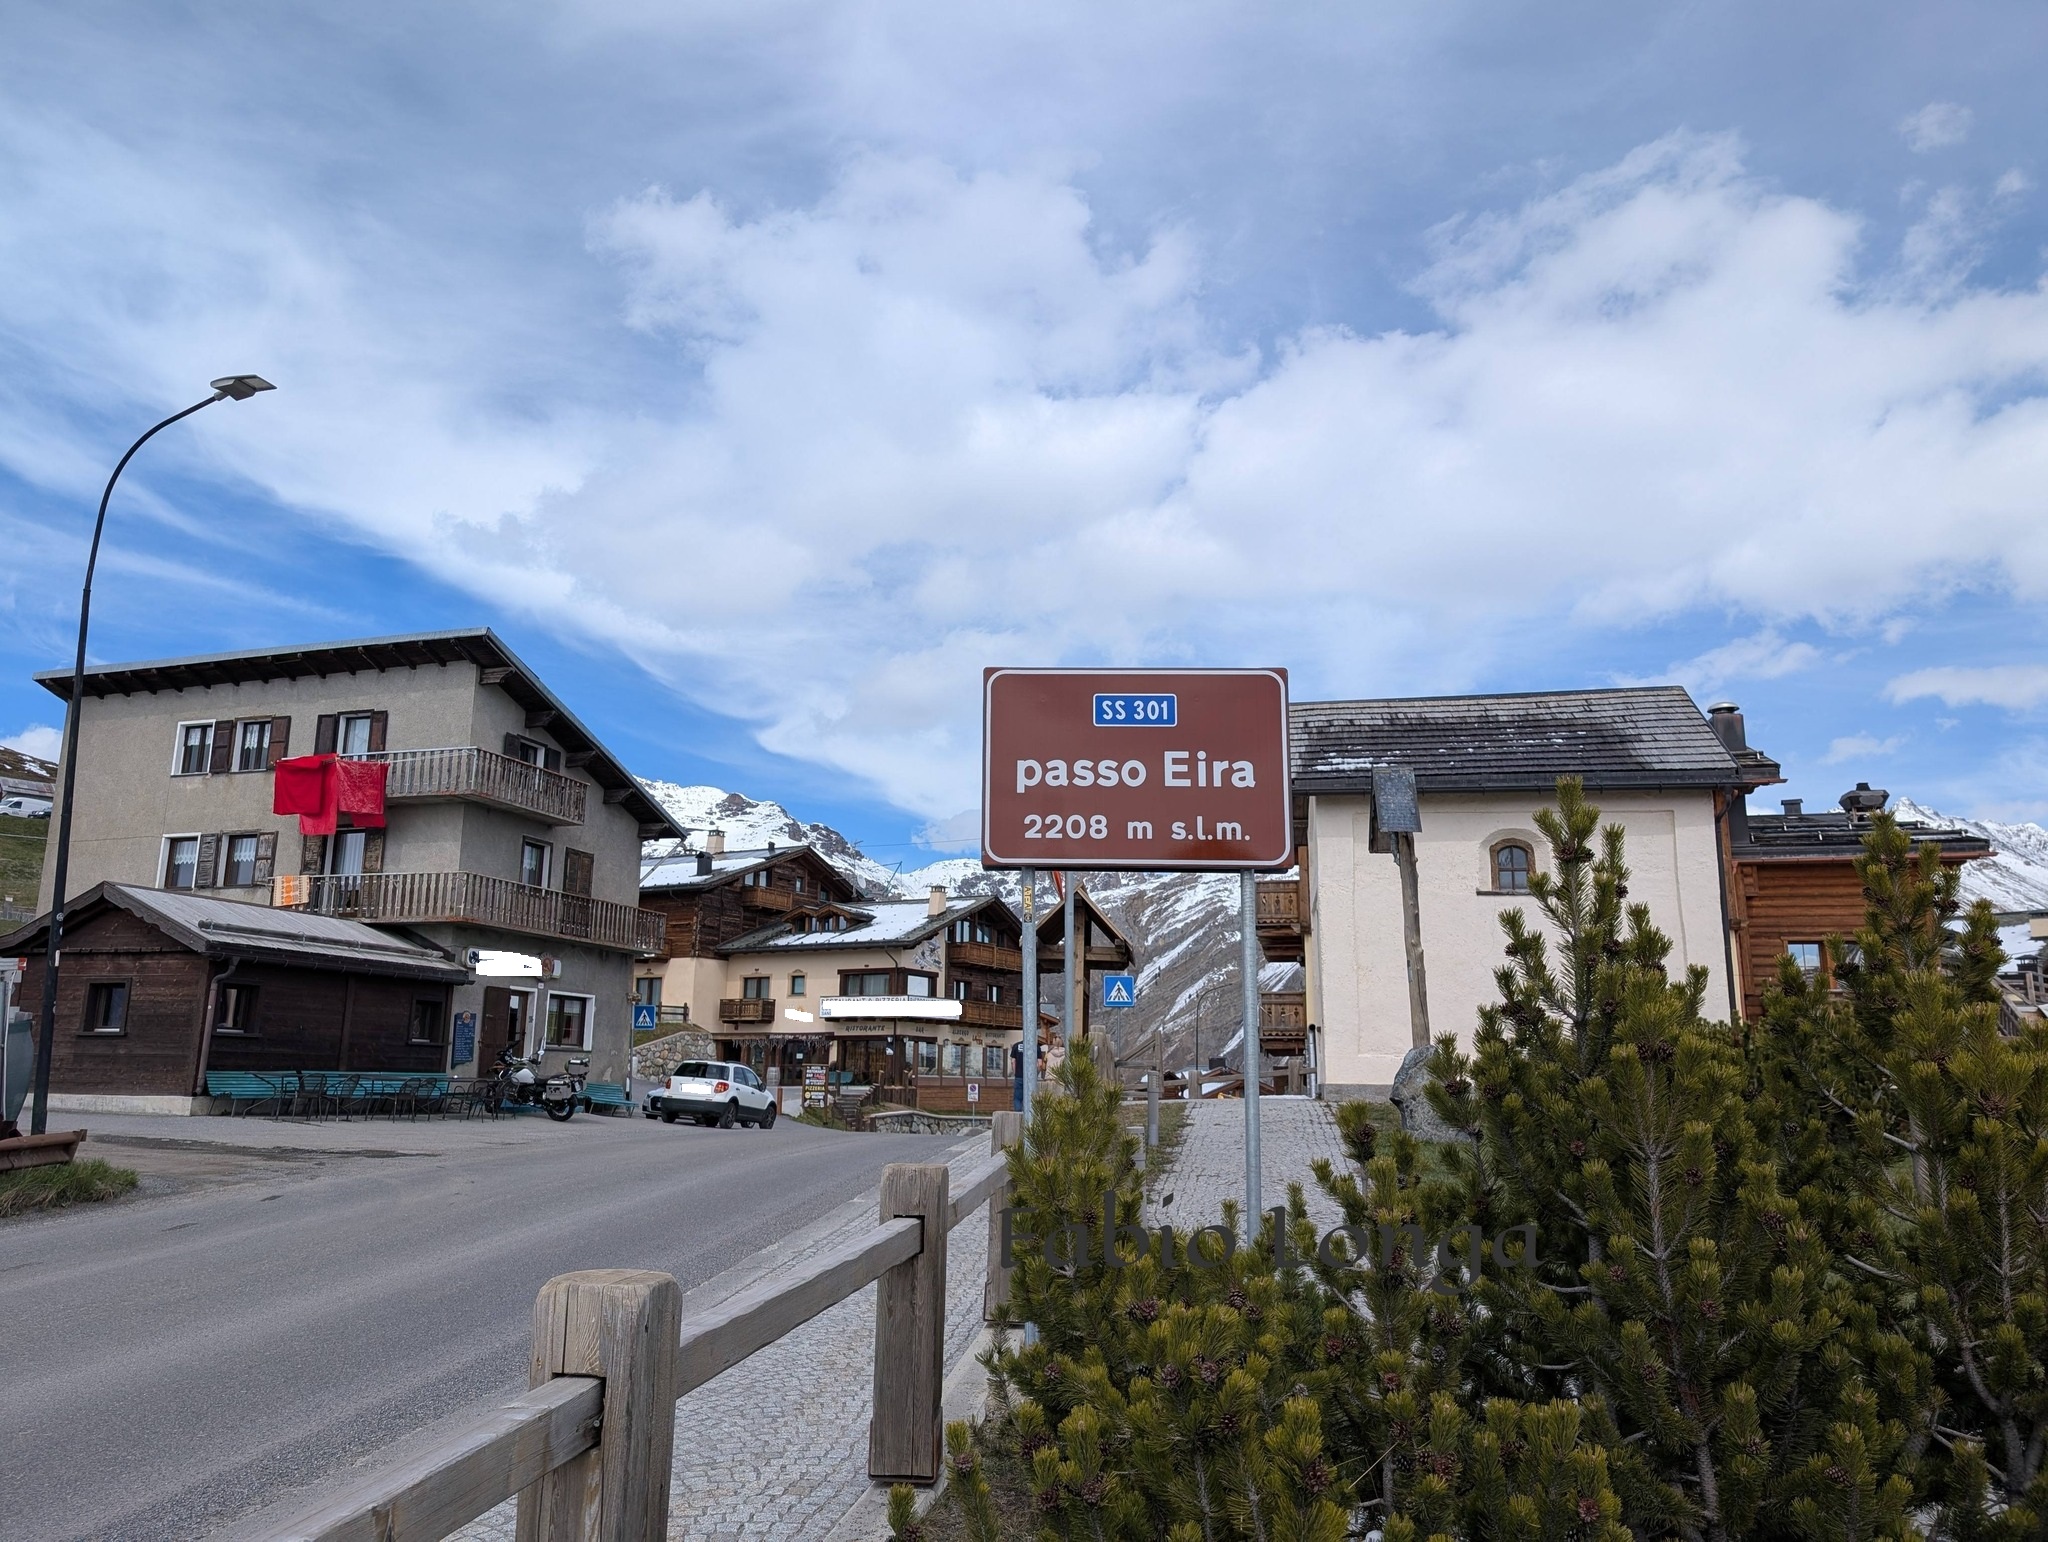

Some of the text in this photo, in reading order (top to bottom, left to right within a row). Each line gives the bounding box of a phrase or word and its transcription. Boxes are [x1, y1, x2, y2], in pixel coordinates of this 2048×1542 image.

[1102, 700, 1168, 720] SS 301
[1016, 750, 1256, 793] passo Eira
[1023, 814, 1251, 841] 2208 m s.l.m.
[845, 1024, 886, 1033] RISTORANTE
